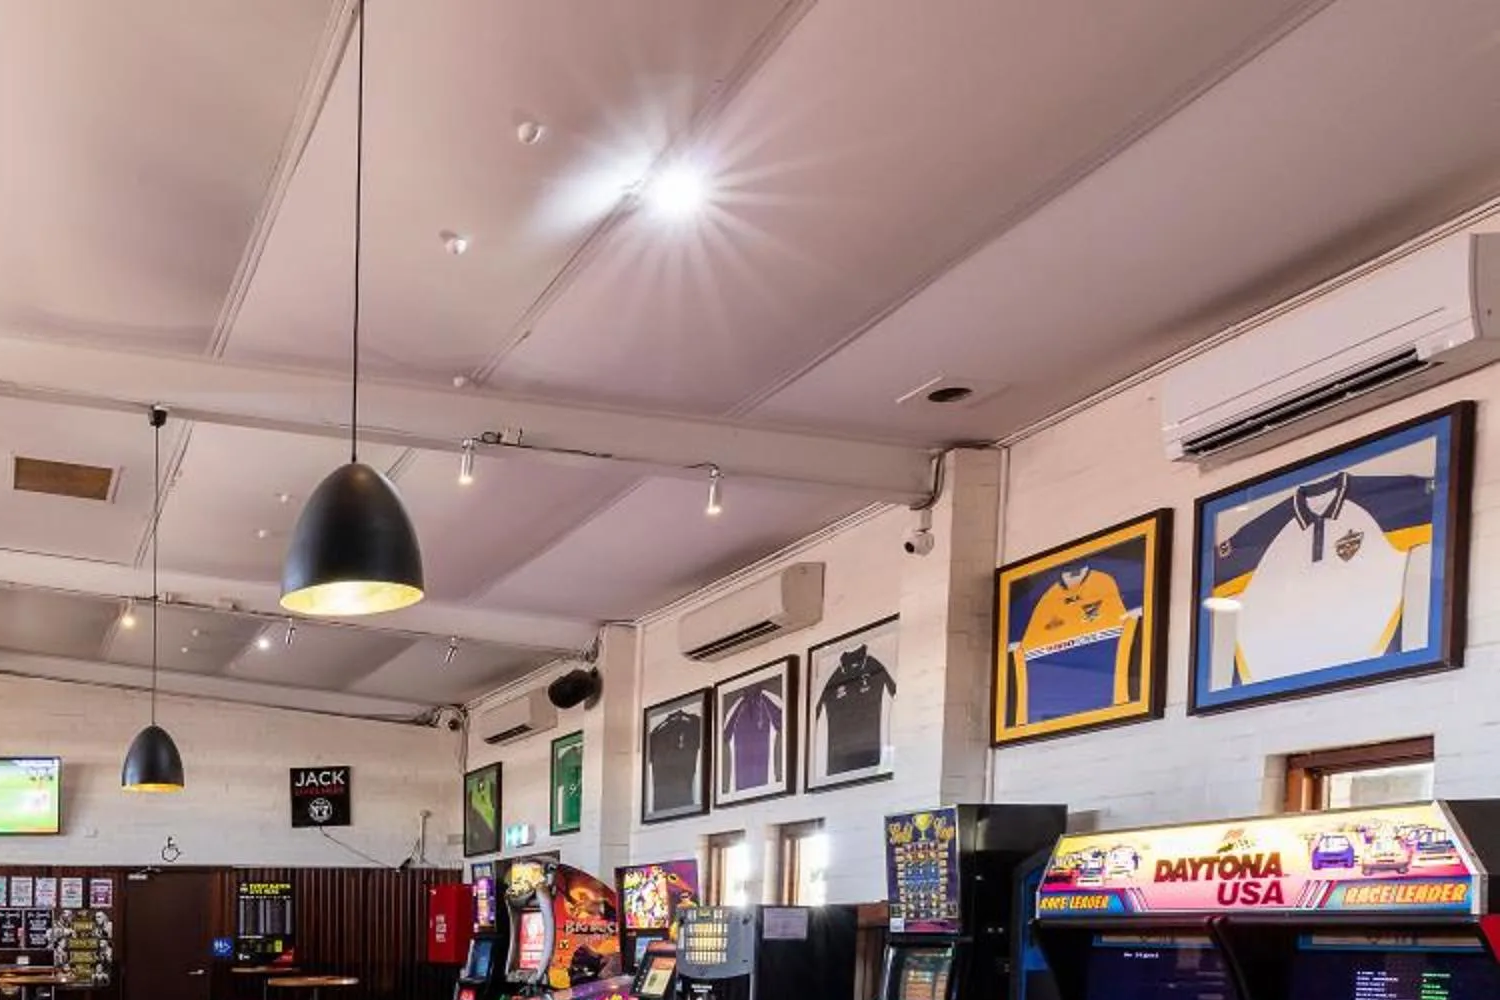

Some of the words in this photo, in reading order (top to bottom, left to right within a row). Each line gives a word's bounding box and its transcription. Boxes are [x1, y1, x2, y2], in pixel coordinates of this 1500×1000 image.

[295, 770, 345, 787] JACK
[1154, 852, 1282, 883] DAYTONA
[1070, 895, 1108, 909] LEADER
[1217, 880, 1285, 906] USA
[1344, 886, 1390, 905] RACE
[1395, 882, 1467, 903] LEADER
